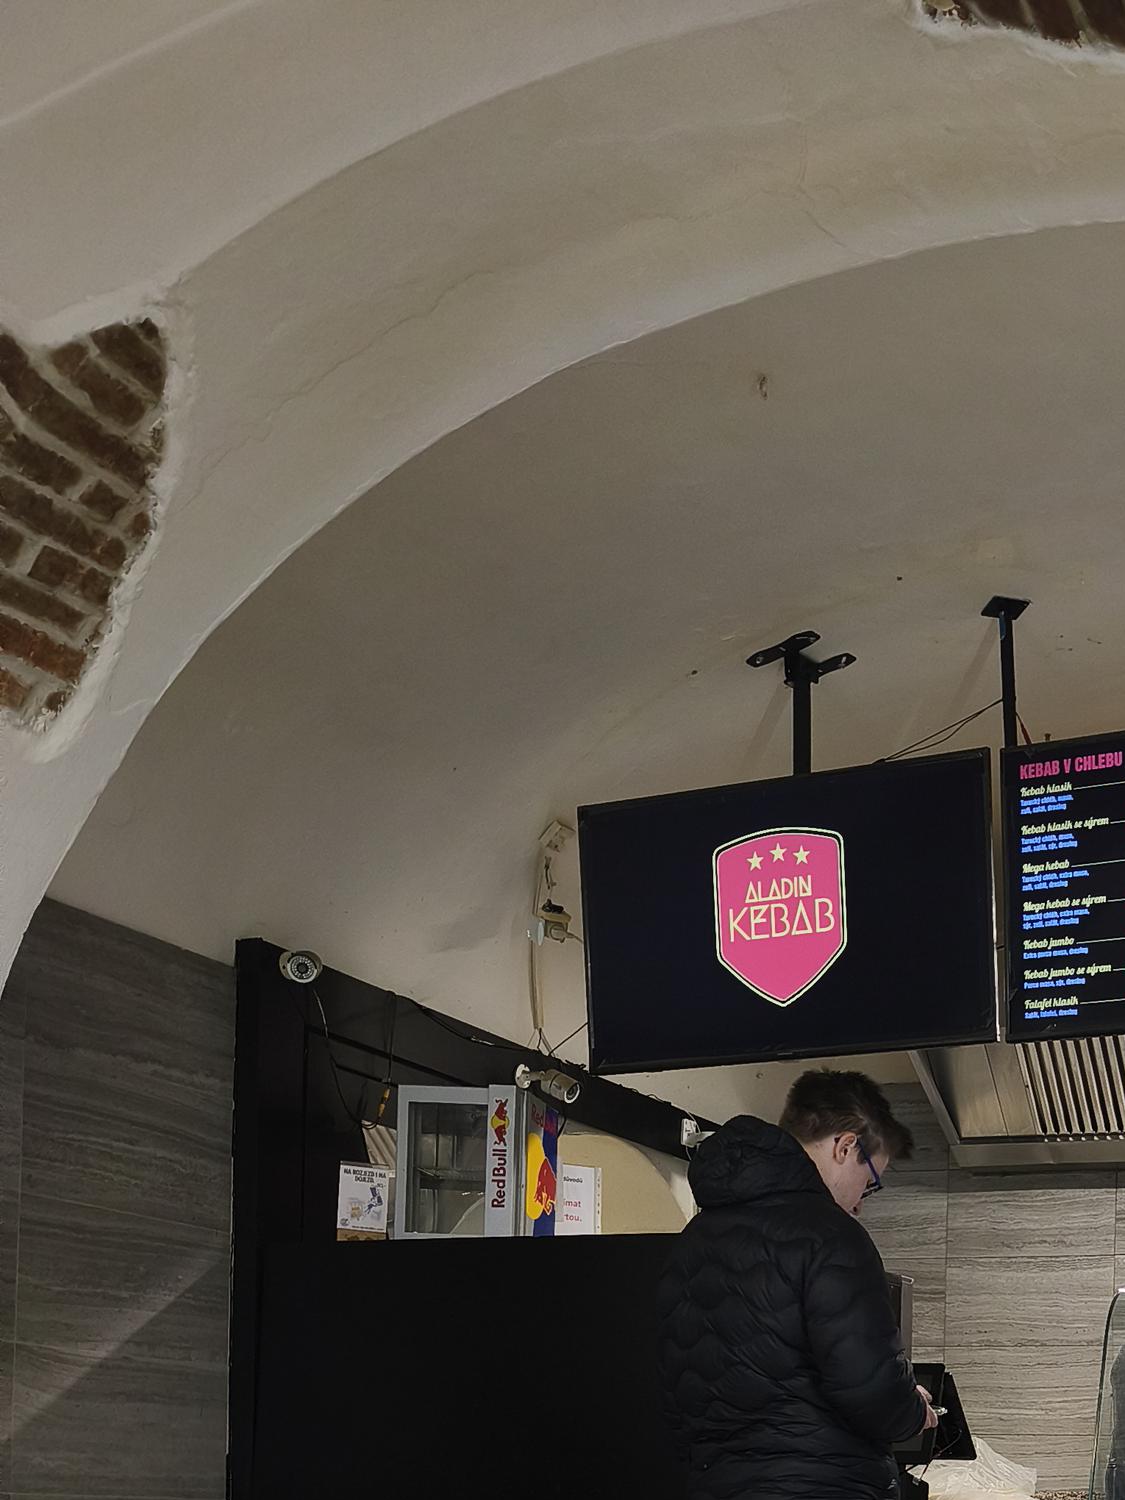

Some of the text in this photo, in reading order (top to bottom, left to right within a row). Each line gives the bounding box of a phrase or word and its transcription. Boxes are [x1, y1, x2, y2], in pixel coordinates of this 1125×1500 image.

[1020, 752, 1122, 779] KEBAB V CHLEBU
[1021, 786, 1045, 796] Kebab
[1047, 782, 1072, 793] klasik
[1021, 825, 1046, 835] Kebab
[1047, 821, 1072, 832] klasik
[1023, 864, 1044, 874] Mega
[1045, 859, 1069, 871] kebab
[745, 875, 812, 903] ALADIN
[1023, 902, 1044, 912] Mega
[1046, 898, 1070, 909] kebab
[729, 898, 835, 942] KEBAB
[1024, 940, 1048, 949] Kebab
[1048, 936, 1074, 949] jumbo
[1024, 969, 1048, 979] Kebab
[1048, 966, 1075, 979] jumbo
[1053, 996, 1078, 1007] klasik
[492, 1149, 506, 1208] Red Bull
